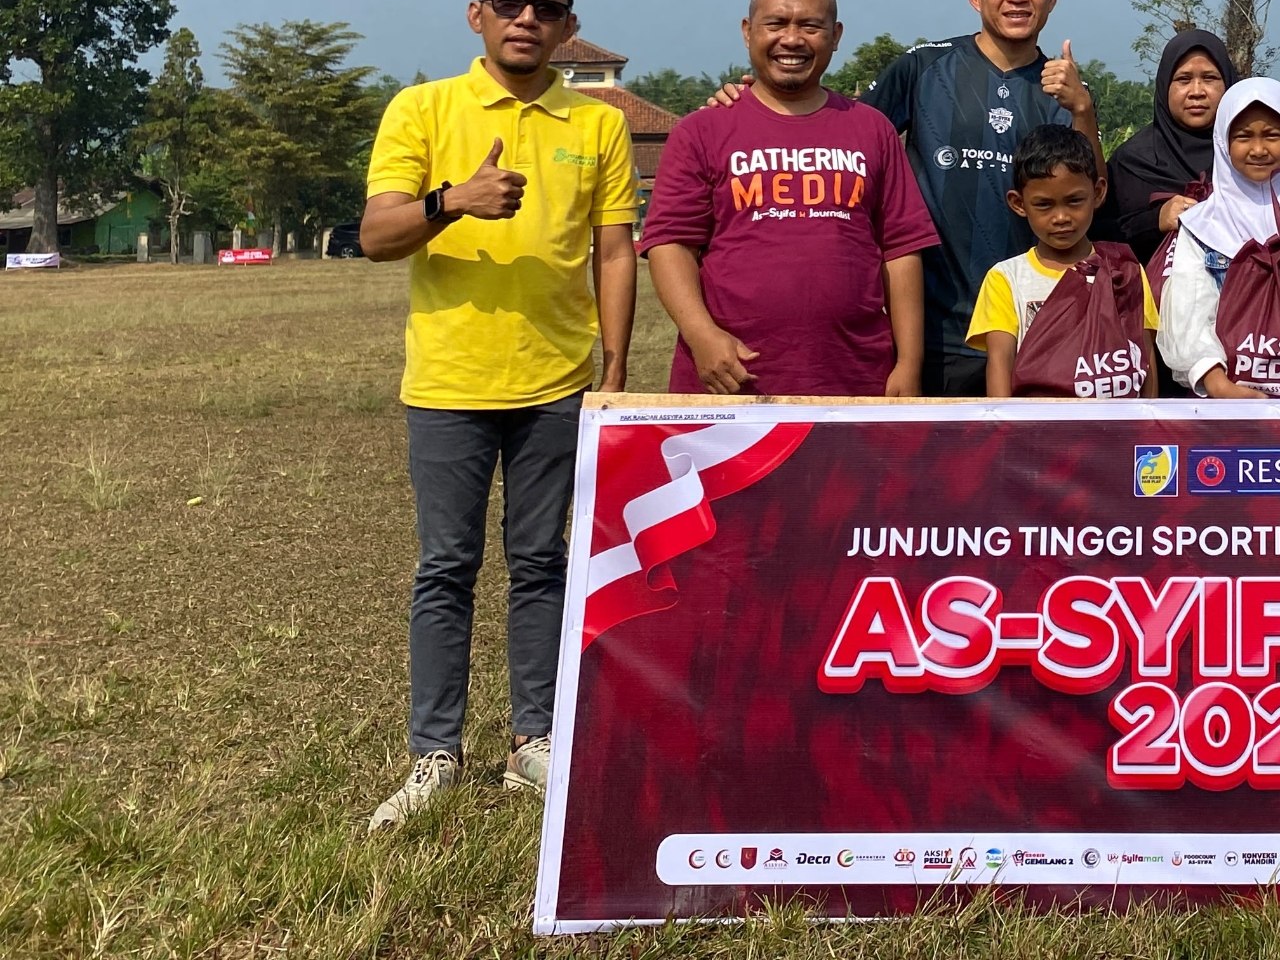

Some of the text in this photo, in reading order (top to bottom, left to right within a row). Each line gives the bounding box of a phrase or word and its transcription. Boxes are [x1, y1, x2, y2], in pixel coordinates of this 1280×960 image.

[731, 148, 867, 177] GATHERING
[961, 148, 994, 160] TOKO
[730, 173, 865, 211] MEDIA
[752, 208, 796, 222] As-Syifa
[808, 208, 851, 221] Journalist
[847, 526, 1012, 557] JUNJUNG
[1018, 526, 1143, 557] TINGGI
[795, 852, 831, 865] Deca
